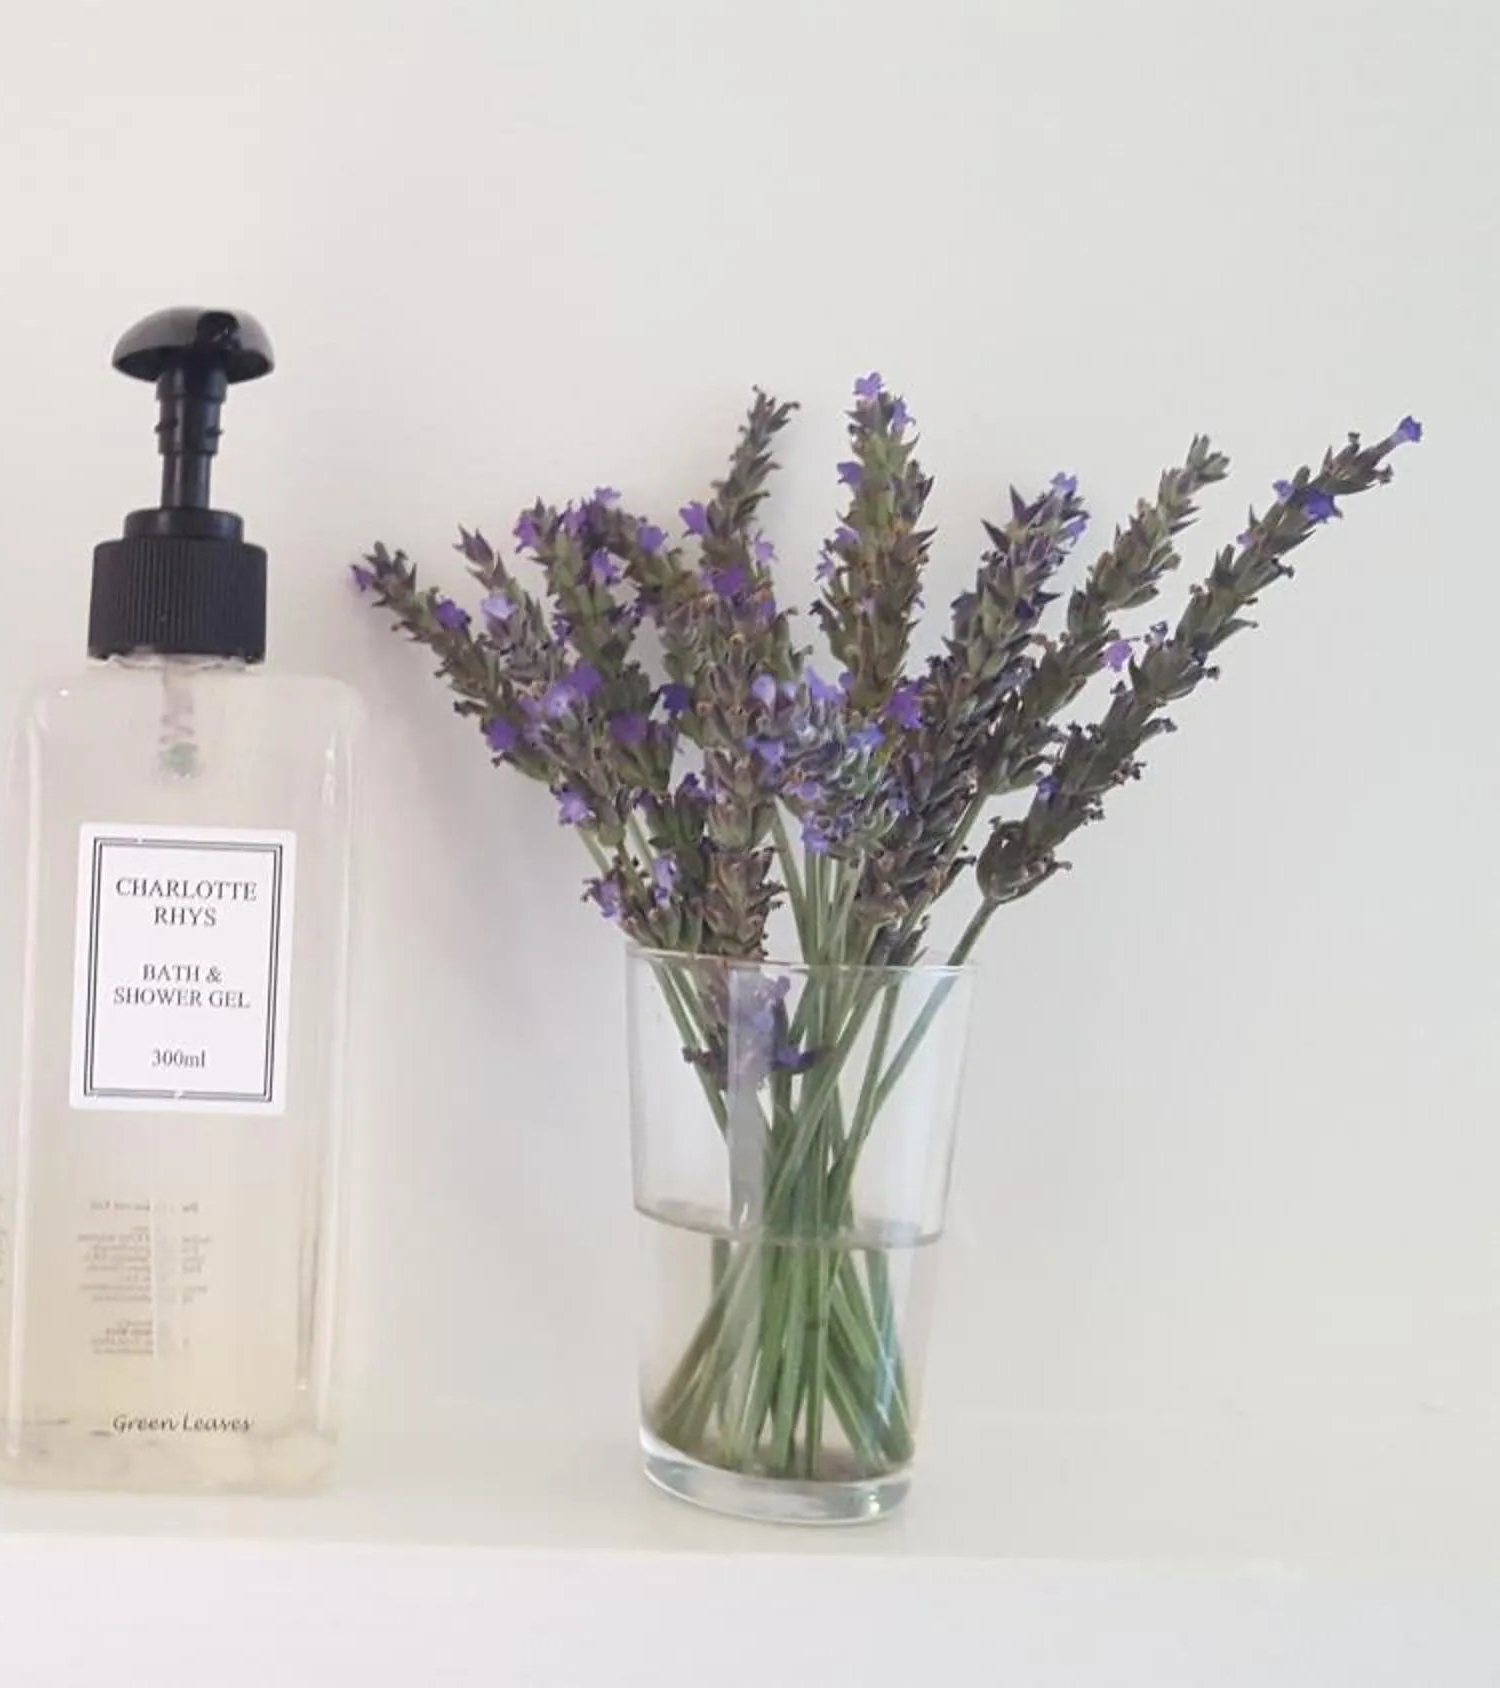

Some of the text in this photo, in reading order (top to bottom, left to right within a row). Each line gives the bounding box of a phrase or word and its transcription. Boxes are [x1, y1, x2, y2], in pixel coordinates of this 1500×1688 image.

[115, 877, 257, 902] CHARLOTTE
[153, 907, 217, 927] RHYS
[142, 963, 222, 984] BATH &
[113, 987, 250, 1009] SHOWER GEL
[151, 1049, 206, 1069] 300ml
[112, 1412, 252, 1434] Green Leaves
